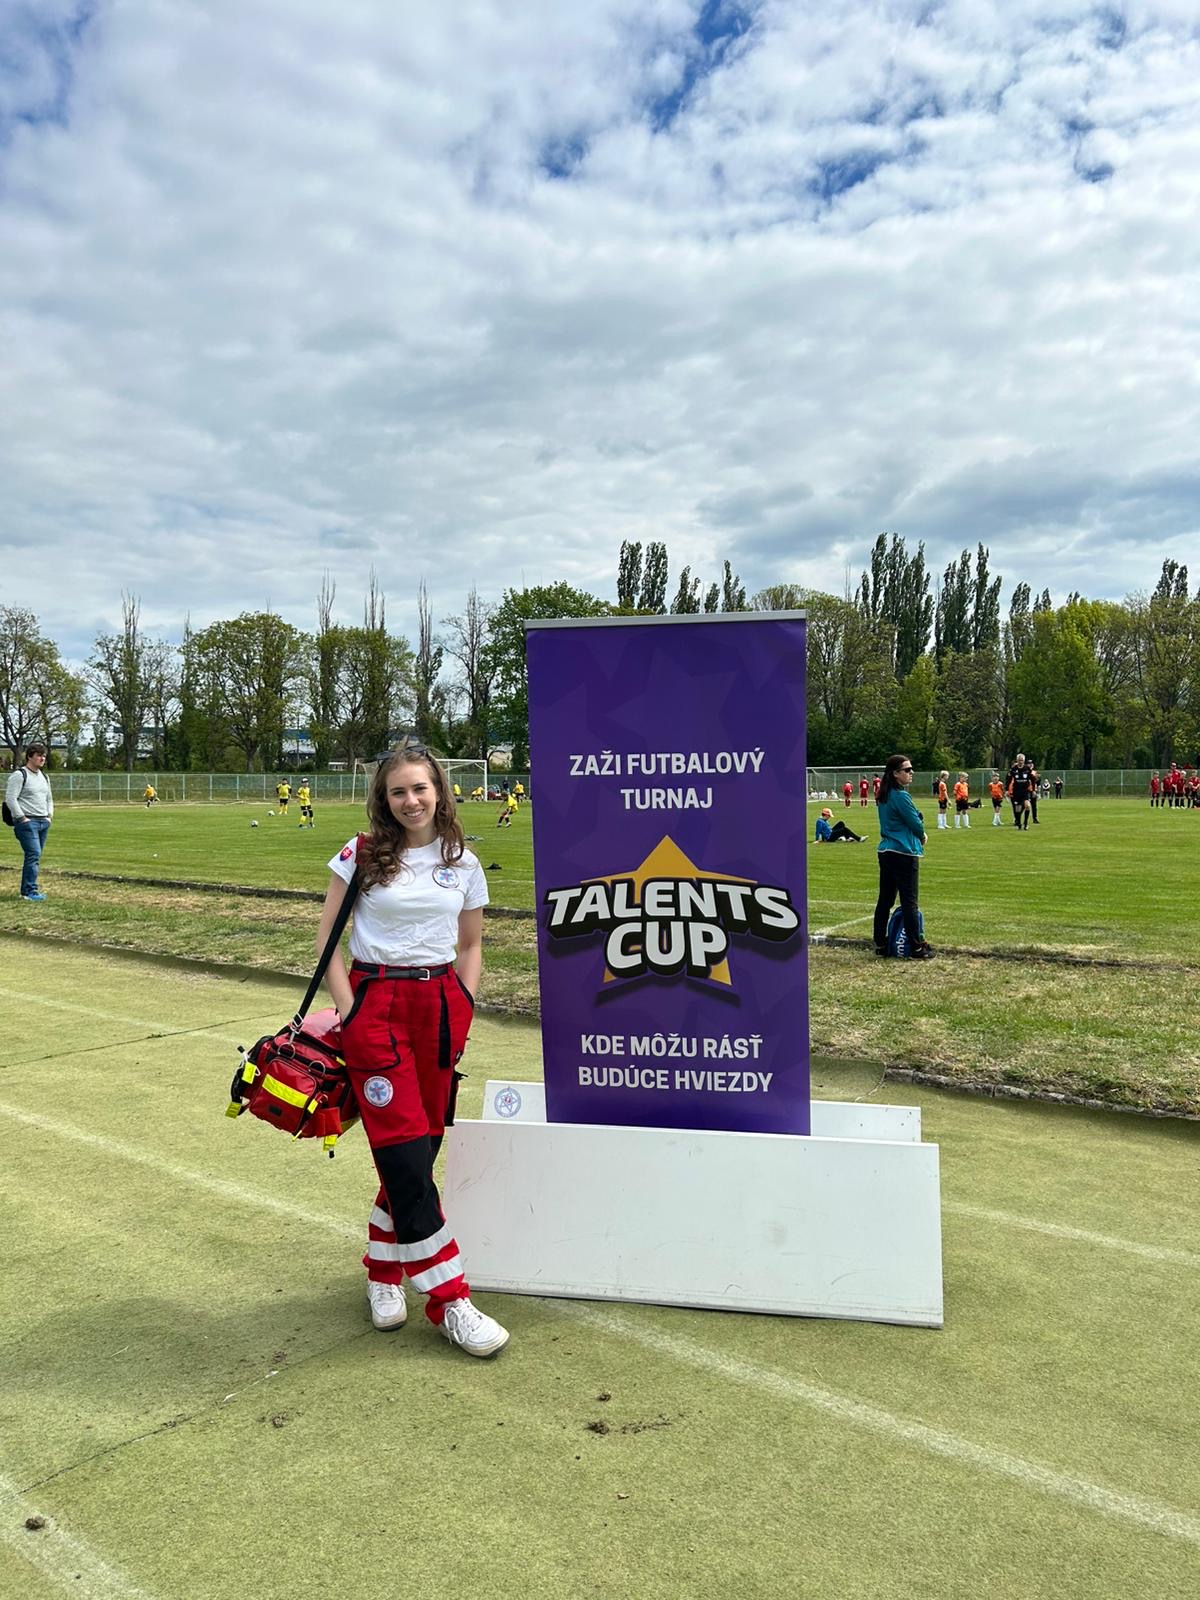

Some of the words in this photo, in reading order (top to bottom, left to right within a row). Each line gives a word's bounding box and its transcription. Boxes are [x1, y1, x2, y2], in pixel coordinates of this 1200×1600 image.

[569, 750, 622, 776] ZAŽI
[627, 747, 765, 775] FUTBALOVÝ
[620, 787, 713, 810] TURNAJ
[547, 880, 800, 930] TALENTS
[606, 920, 728, 970] CUP
[580, 1034, 626, 1055] KDE
[630, 1032, 697, 1057] MÔŽU
[703, 1034, 763, 1059] RÁSŤ
[578, 1064, 670, 1089] BUDÚCE
[675, 1070, 773, 1092] HVIEZDY
